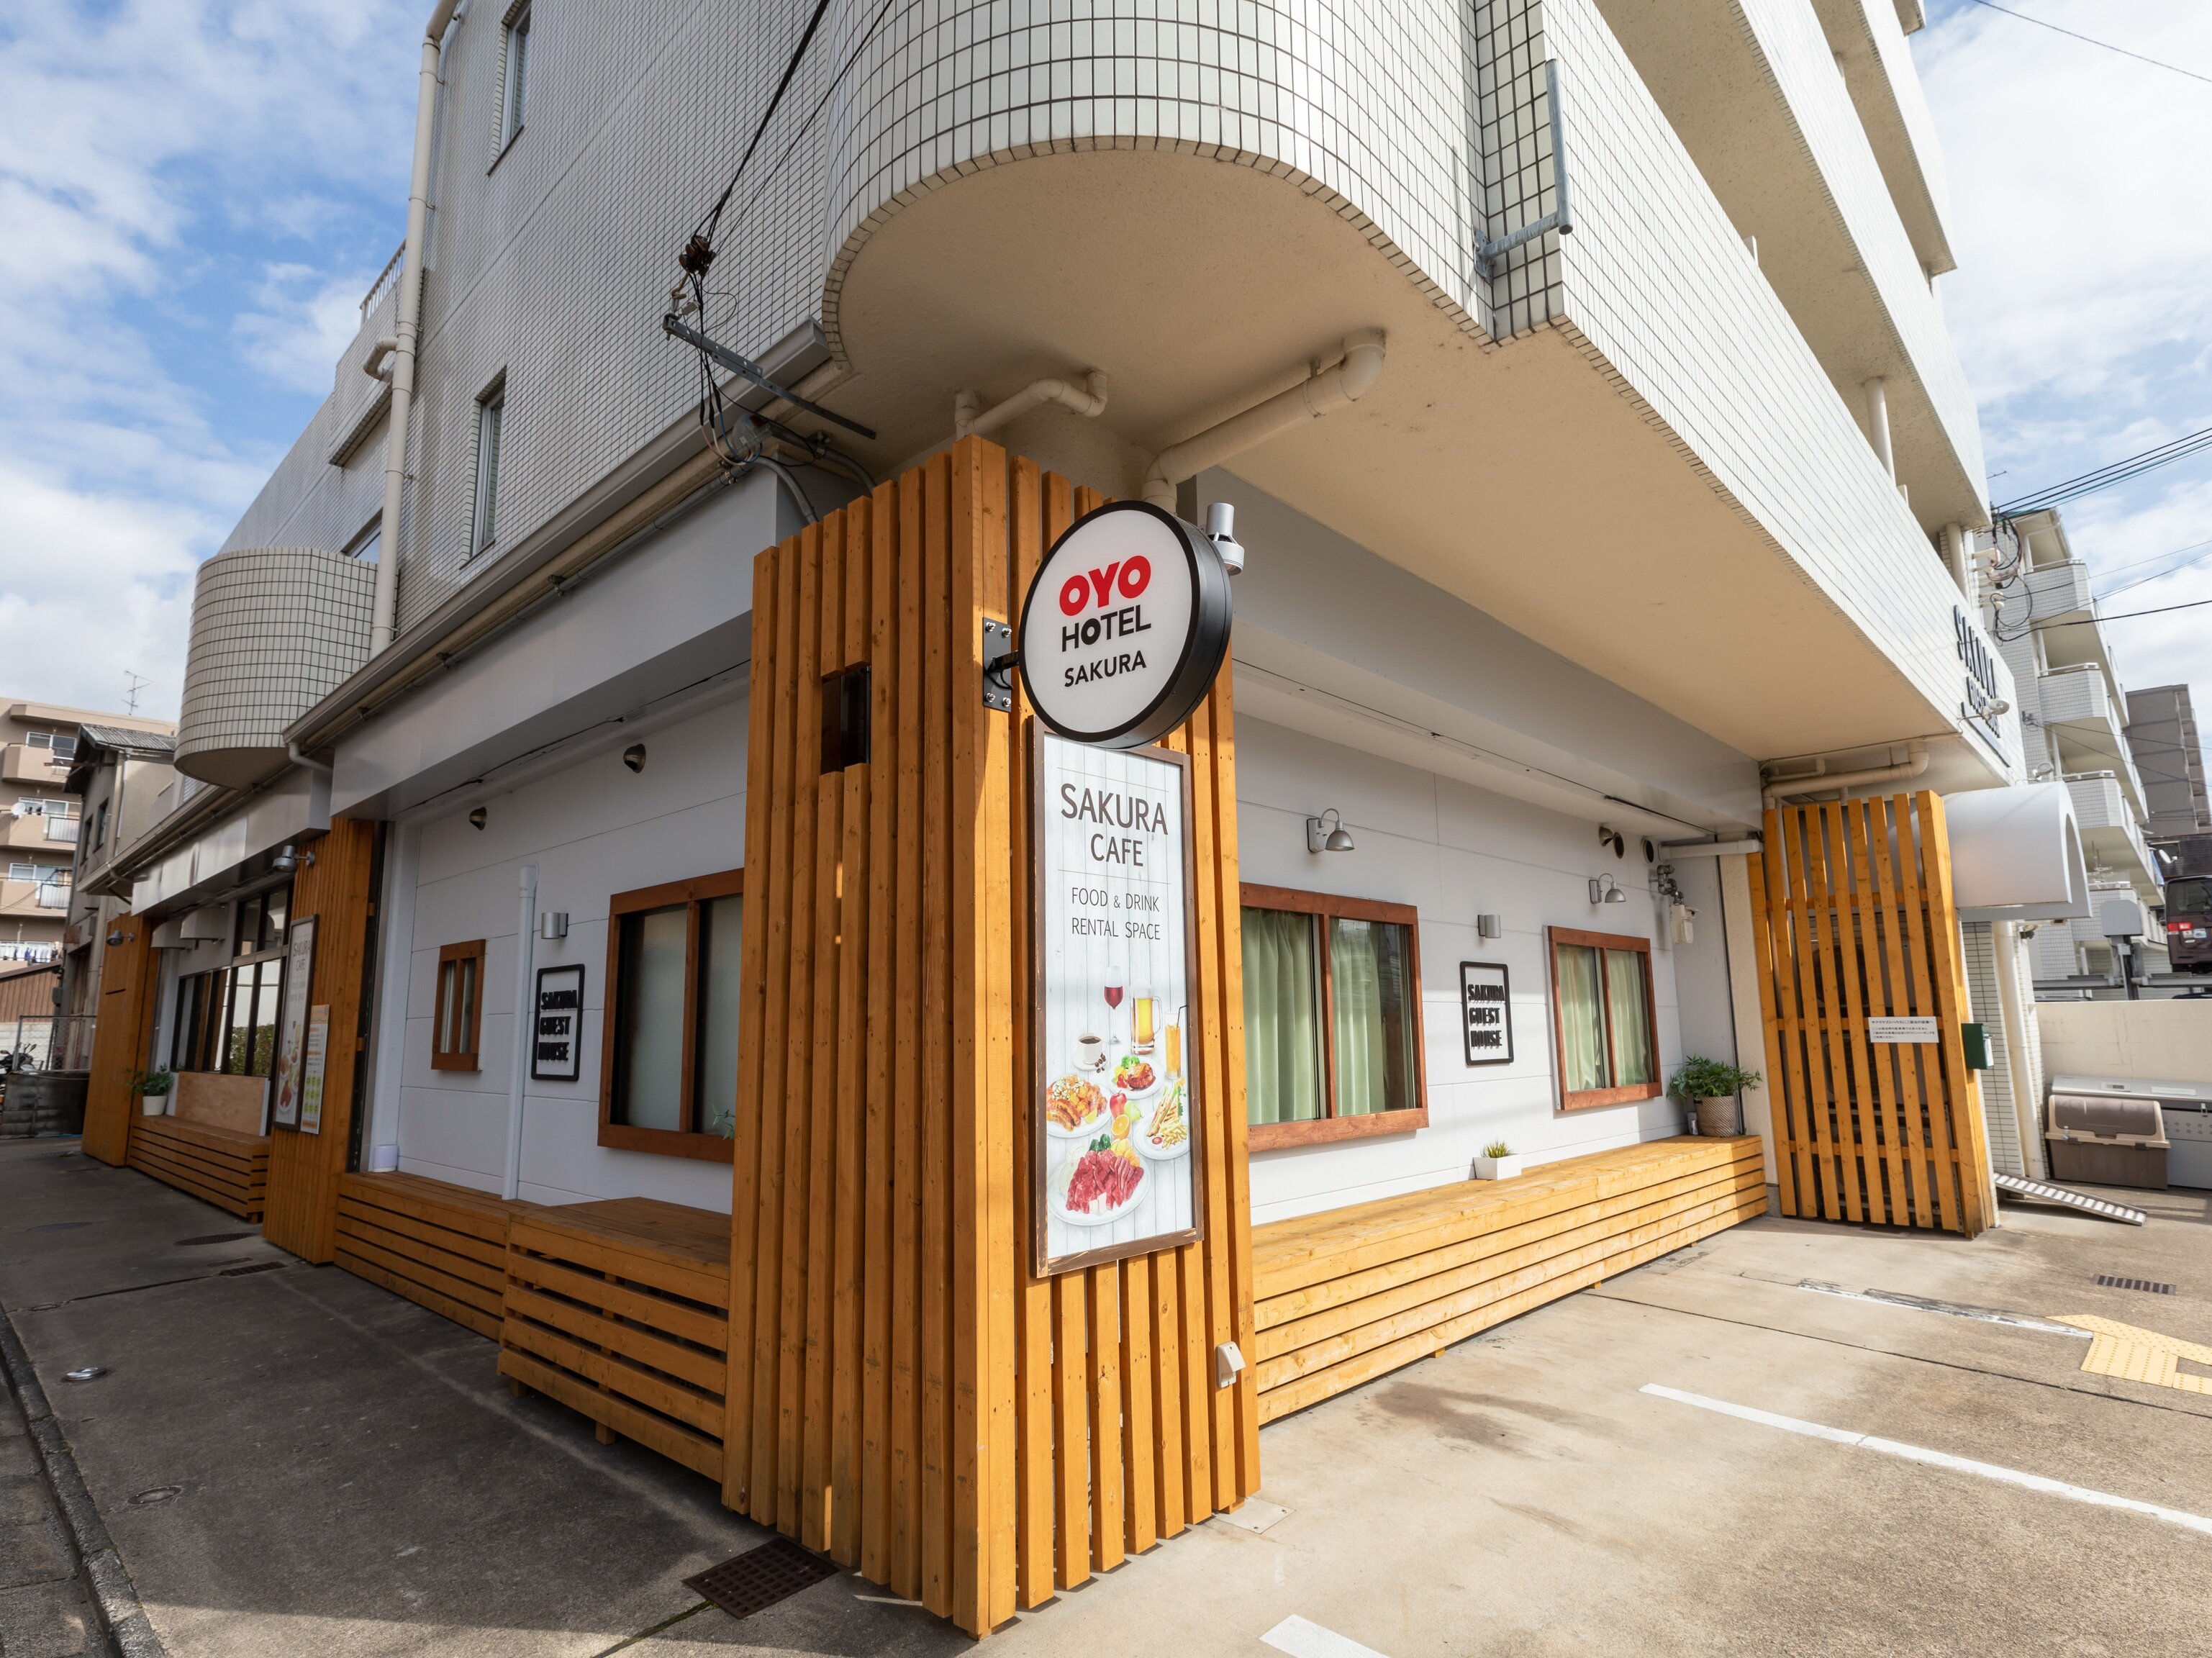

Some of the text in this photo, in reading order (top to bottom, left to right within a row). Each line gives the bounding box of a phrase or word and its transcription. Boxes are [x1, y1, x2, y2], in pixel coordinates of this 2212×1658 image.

[1059, 555, 1151, 617] OYO
[1061, 604, 1151, 653] HOTEL
[1064, 650, 1147, 687] SAKURA
[1061, 783, 1169, 835] SAKURA
[1090, 833, 1143, 867] CAFE
[1071, 887, 1160, 912] FOOD & DRINK
[1071, 918, 1161, 941] RENTAL SPACE
[1467, 984, 1505, 1002] SAKURA
[539, 1016, 571, 1036] GUEST
[1469, 1007, 1500, 1024] GUEST
[1470, 1030, 1502, 1047] HOUSE
[538, 1042, 570, 1061] HOUSE
